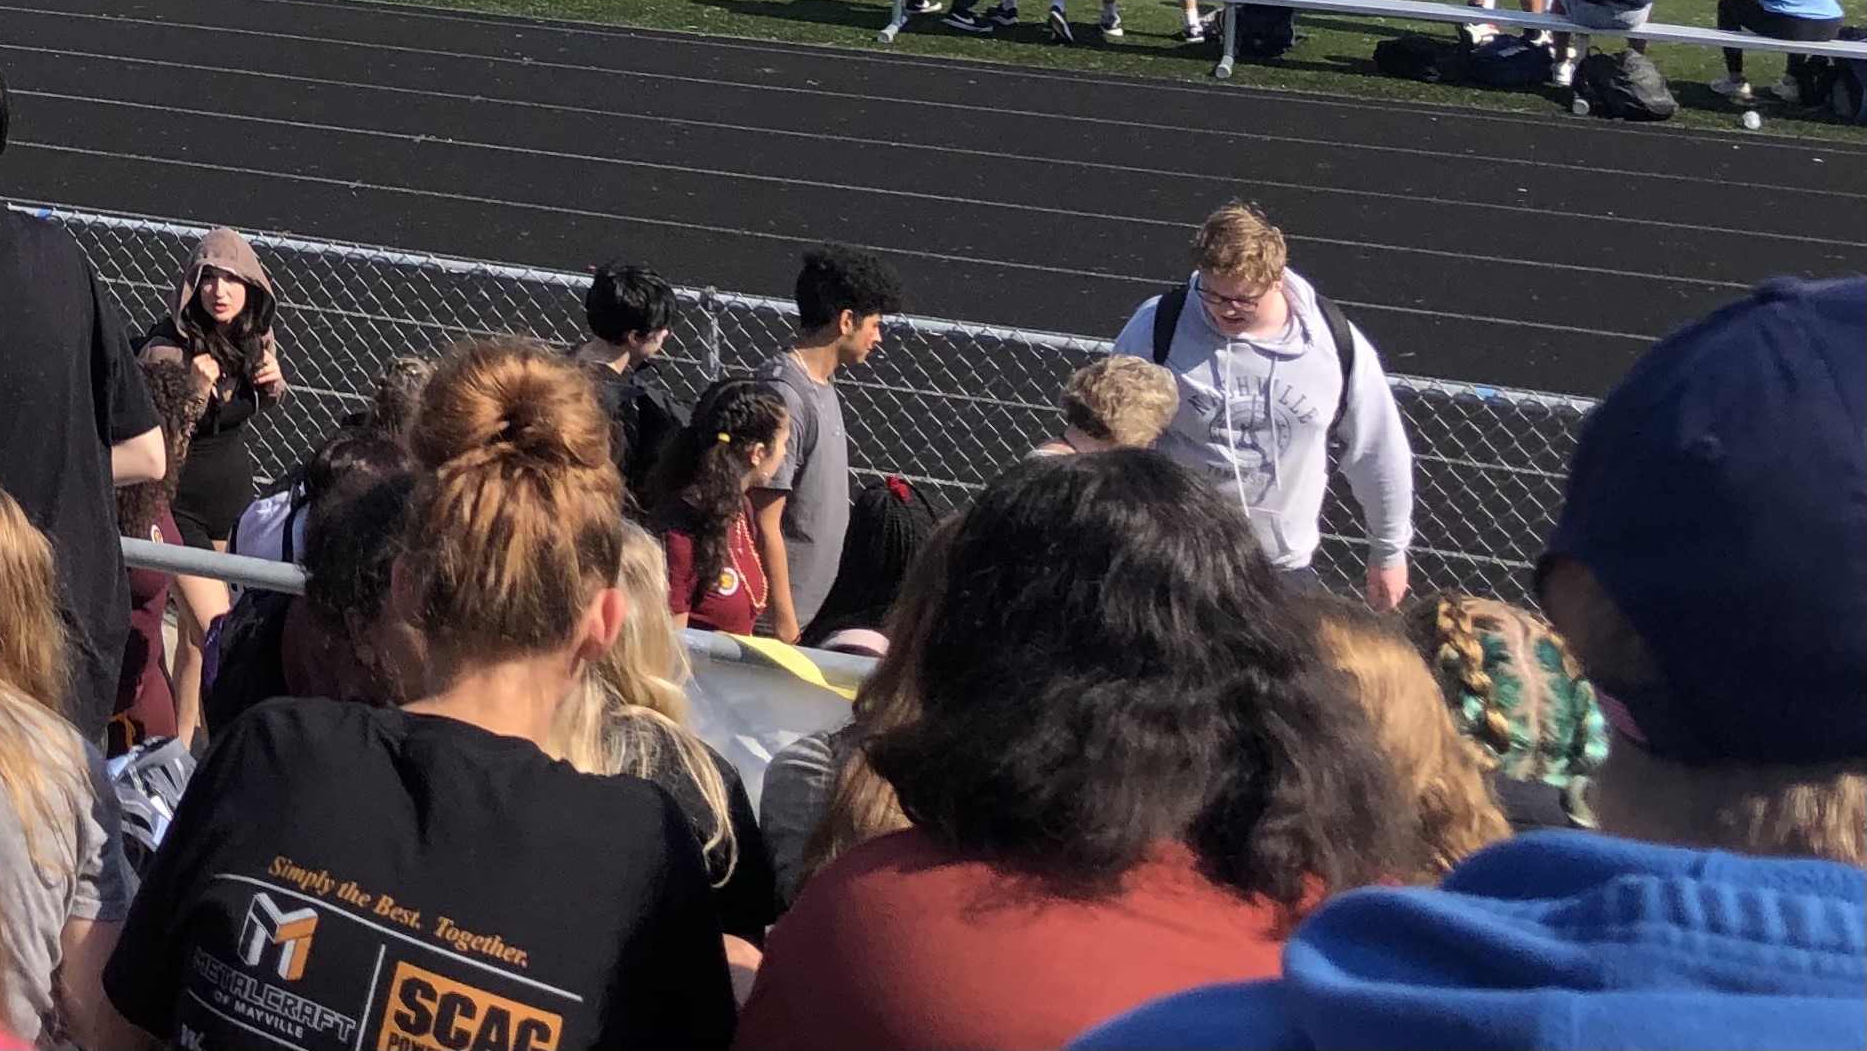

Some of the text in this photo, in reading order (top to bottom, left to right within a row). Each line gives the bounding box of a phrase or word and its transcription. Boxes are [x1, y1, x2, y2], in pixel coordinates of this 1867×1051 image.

[267, 854, 528, 969] Simply the Best. Together.
[192, 946, 357, 1044] METALCRAFT
[213, 989, 304, 1039] OF MAYVILLE
